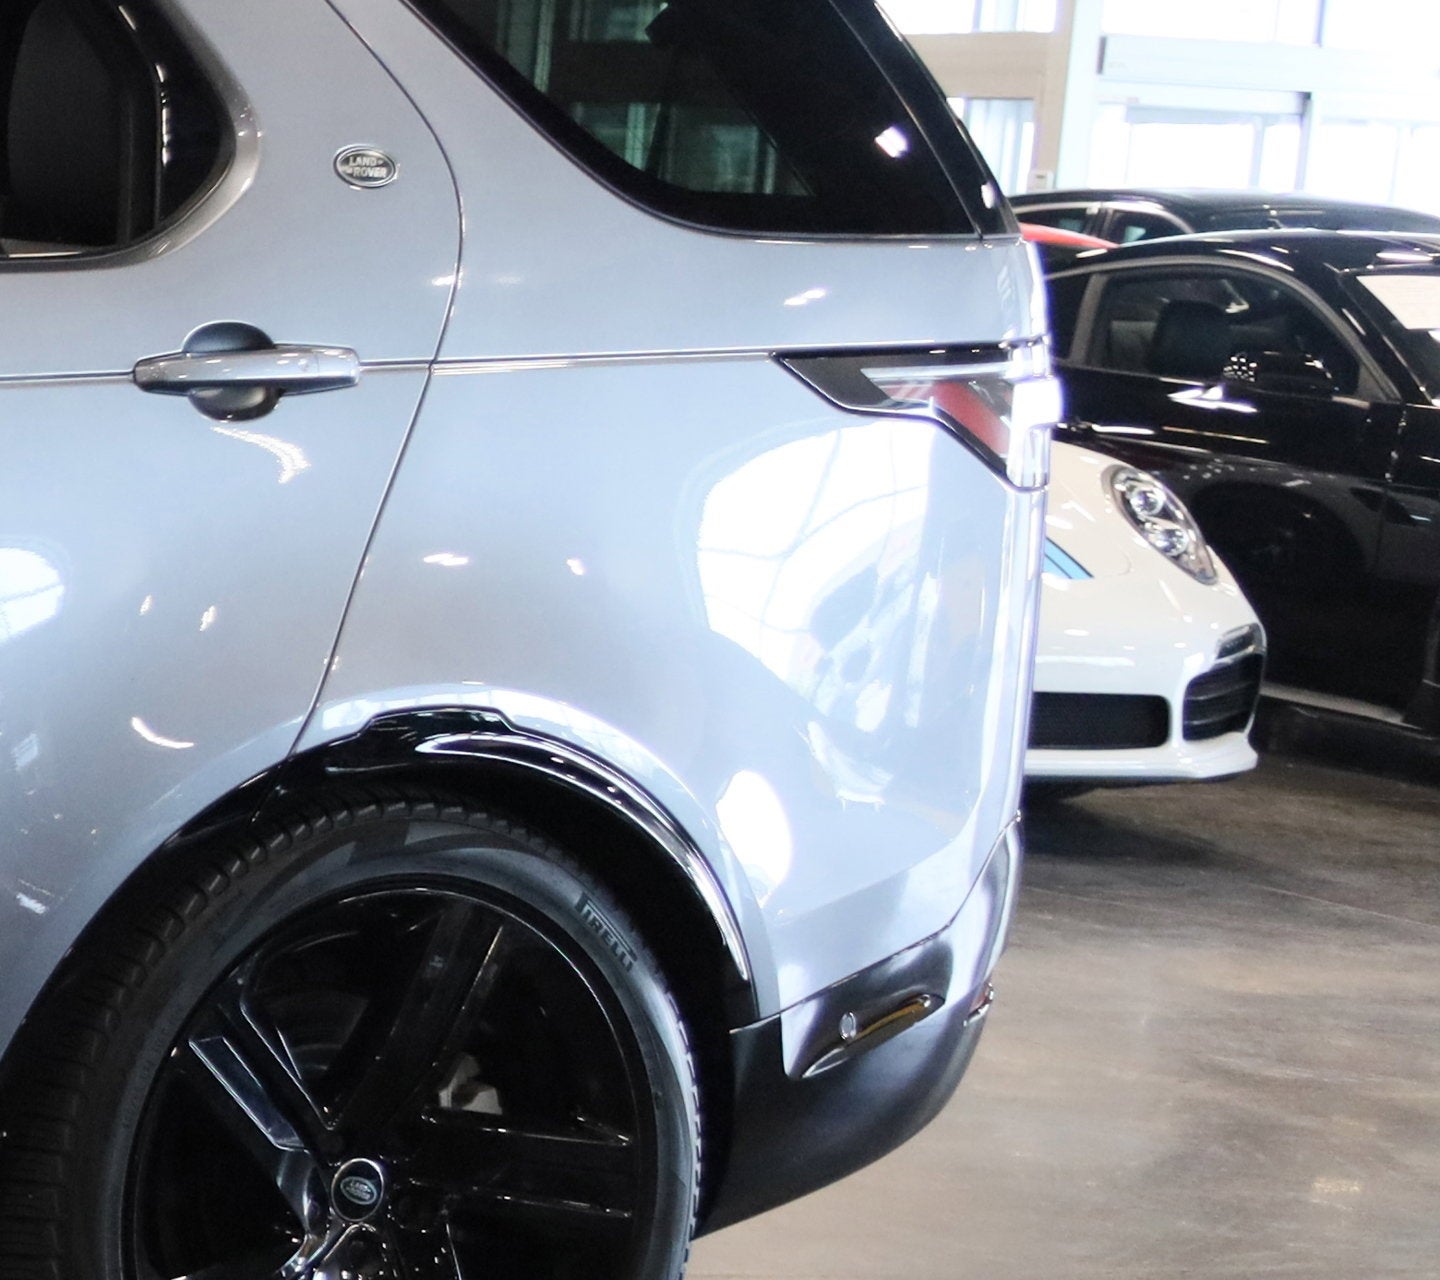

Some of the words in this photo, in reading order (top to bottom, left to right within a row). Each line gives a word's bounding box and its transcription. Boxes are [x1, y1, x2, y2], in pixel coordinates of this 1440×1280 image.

[349, 157, 376, 166] LAND
[353, 166, 388, 178] ROVER
[575, 892, 637, 972] PIRELLI
